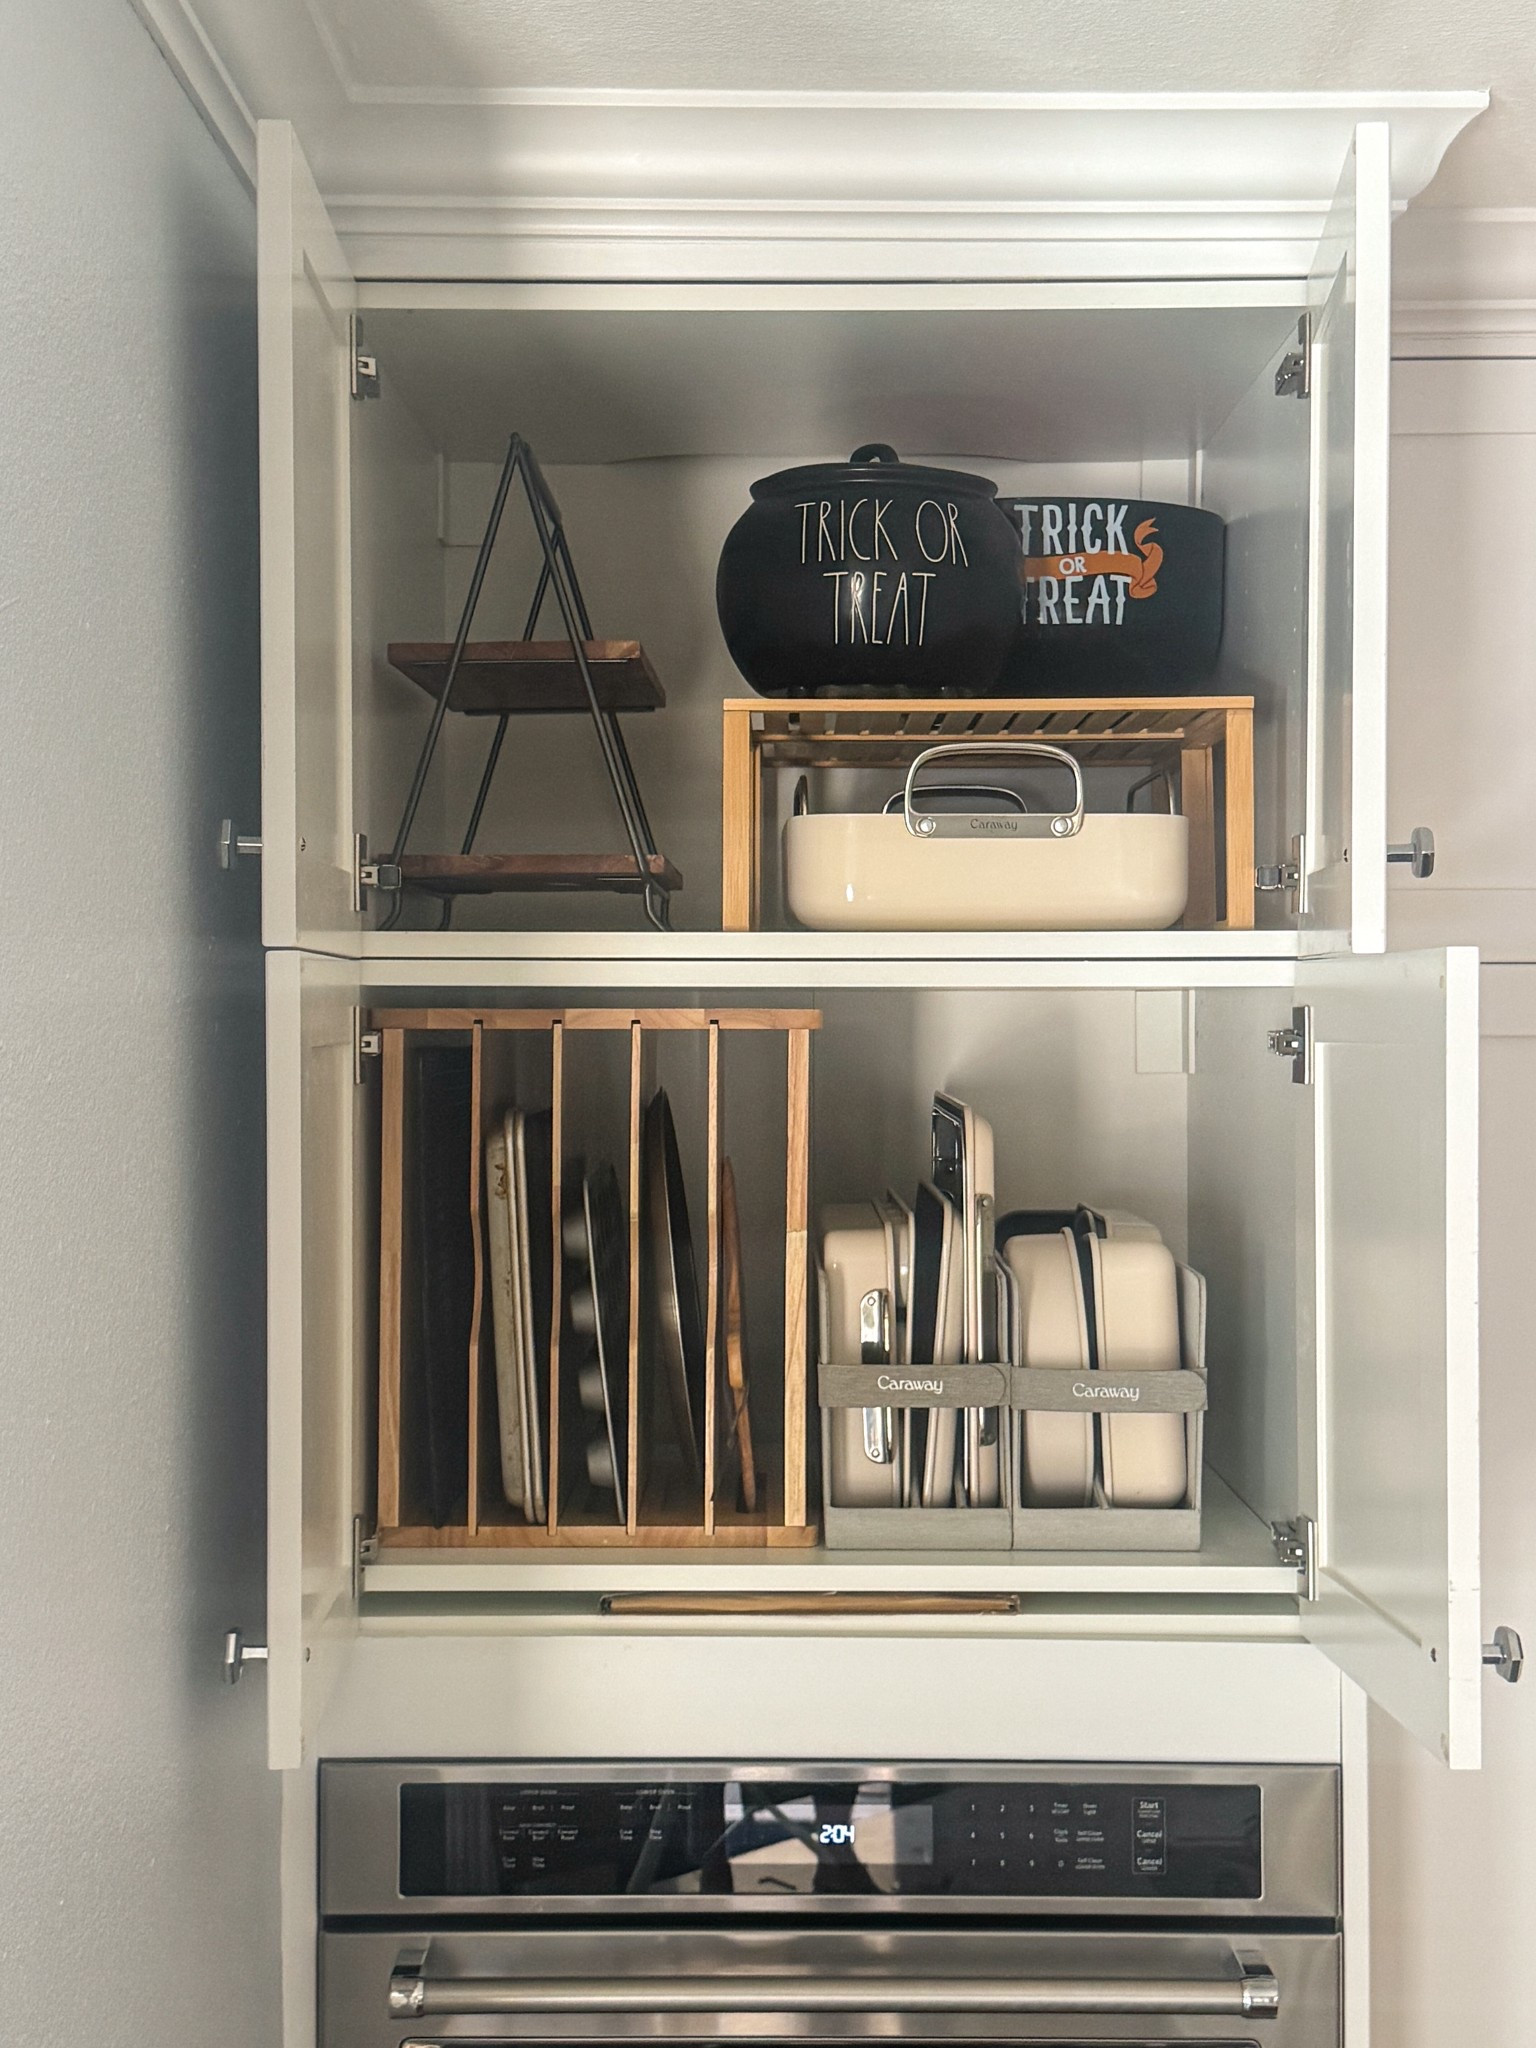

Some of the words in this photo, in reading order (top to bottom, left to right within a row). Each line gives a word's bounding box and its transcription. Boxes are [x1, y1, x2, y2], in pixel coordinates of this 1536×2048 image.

[794, 498, 898, 564] TRICK
[915, 500, 968, 567] OR
[1013, 503, 1129, 555] TRICK
[1059, 556, 1087, 575] OR
[822, 571, 937, 646] TREAT
[970, 818, 1018, 832] Caraway
[877, 1375, 943, 1394] Caraway
[1072, 1383, 1140, 1401] Caraway
[1140, 1801, 1159, 1809] Start
[1136, 1829, 1162, 1838] Cancel
[1136, 1857, 1162, 1866] Cancel
